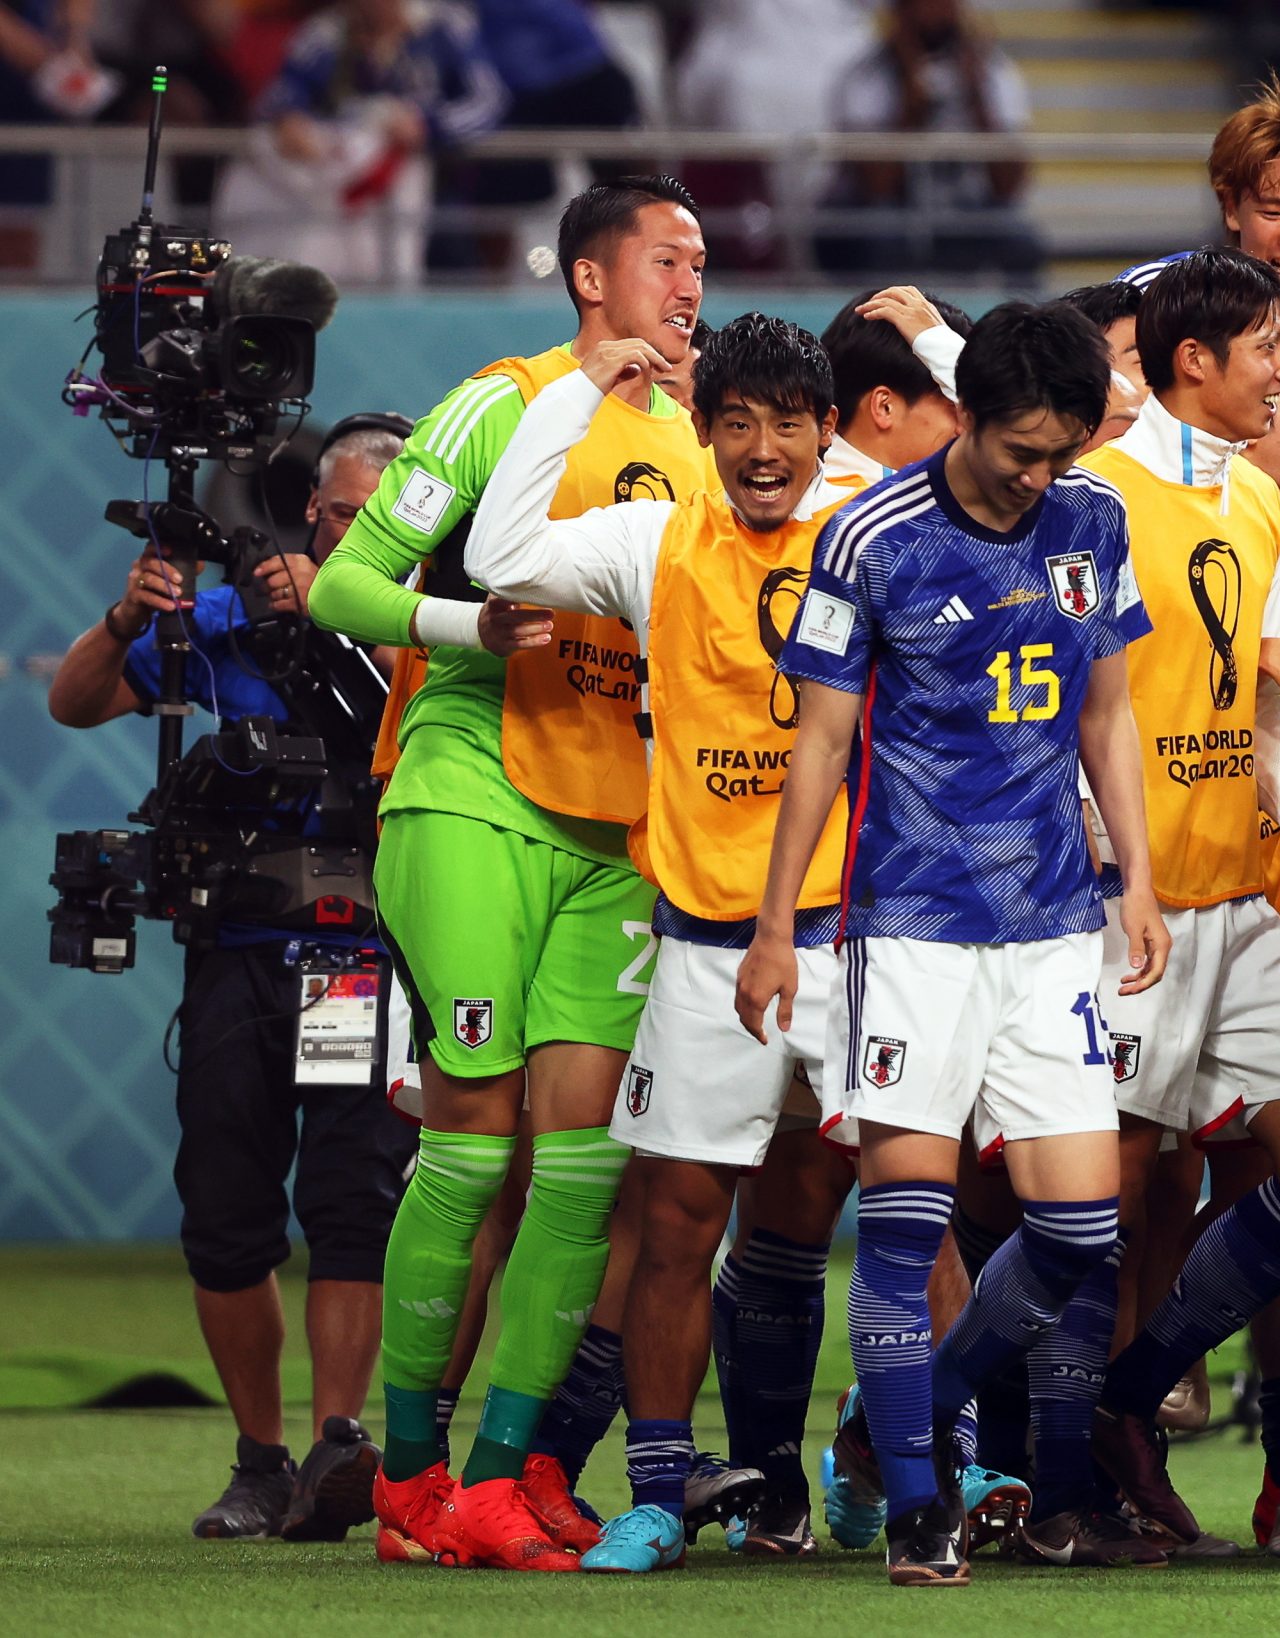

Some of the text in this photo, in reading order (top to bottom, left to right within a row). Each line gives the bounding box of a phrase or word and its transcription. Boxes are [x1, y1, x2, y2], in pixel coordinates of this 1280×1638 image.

[1059, 555, 1083, 564] JAPAN
[559, 640, 598, 665] FIFA
[567, 665, 641, 702] Qatar
[986, 643, 1060, 723] 15
[1156, 729, 1253, 756] FIFA ORLD
[697, 748, 751, 769] FIFA
[706, 772, 785, 803] Qat
[1070, 991, 1112, 1065] 1
[877, 1037, 899, 1045] JAPAN
[736, 1310, 812, 1325] JAPAN
[1053, 1366, 1106, 1384] JAP
